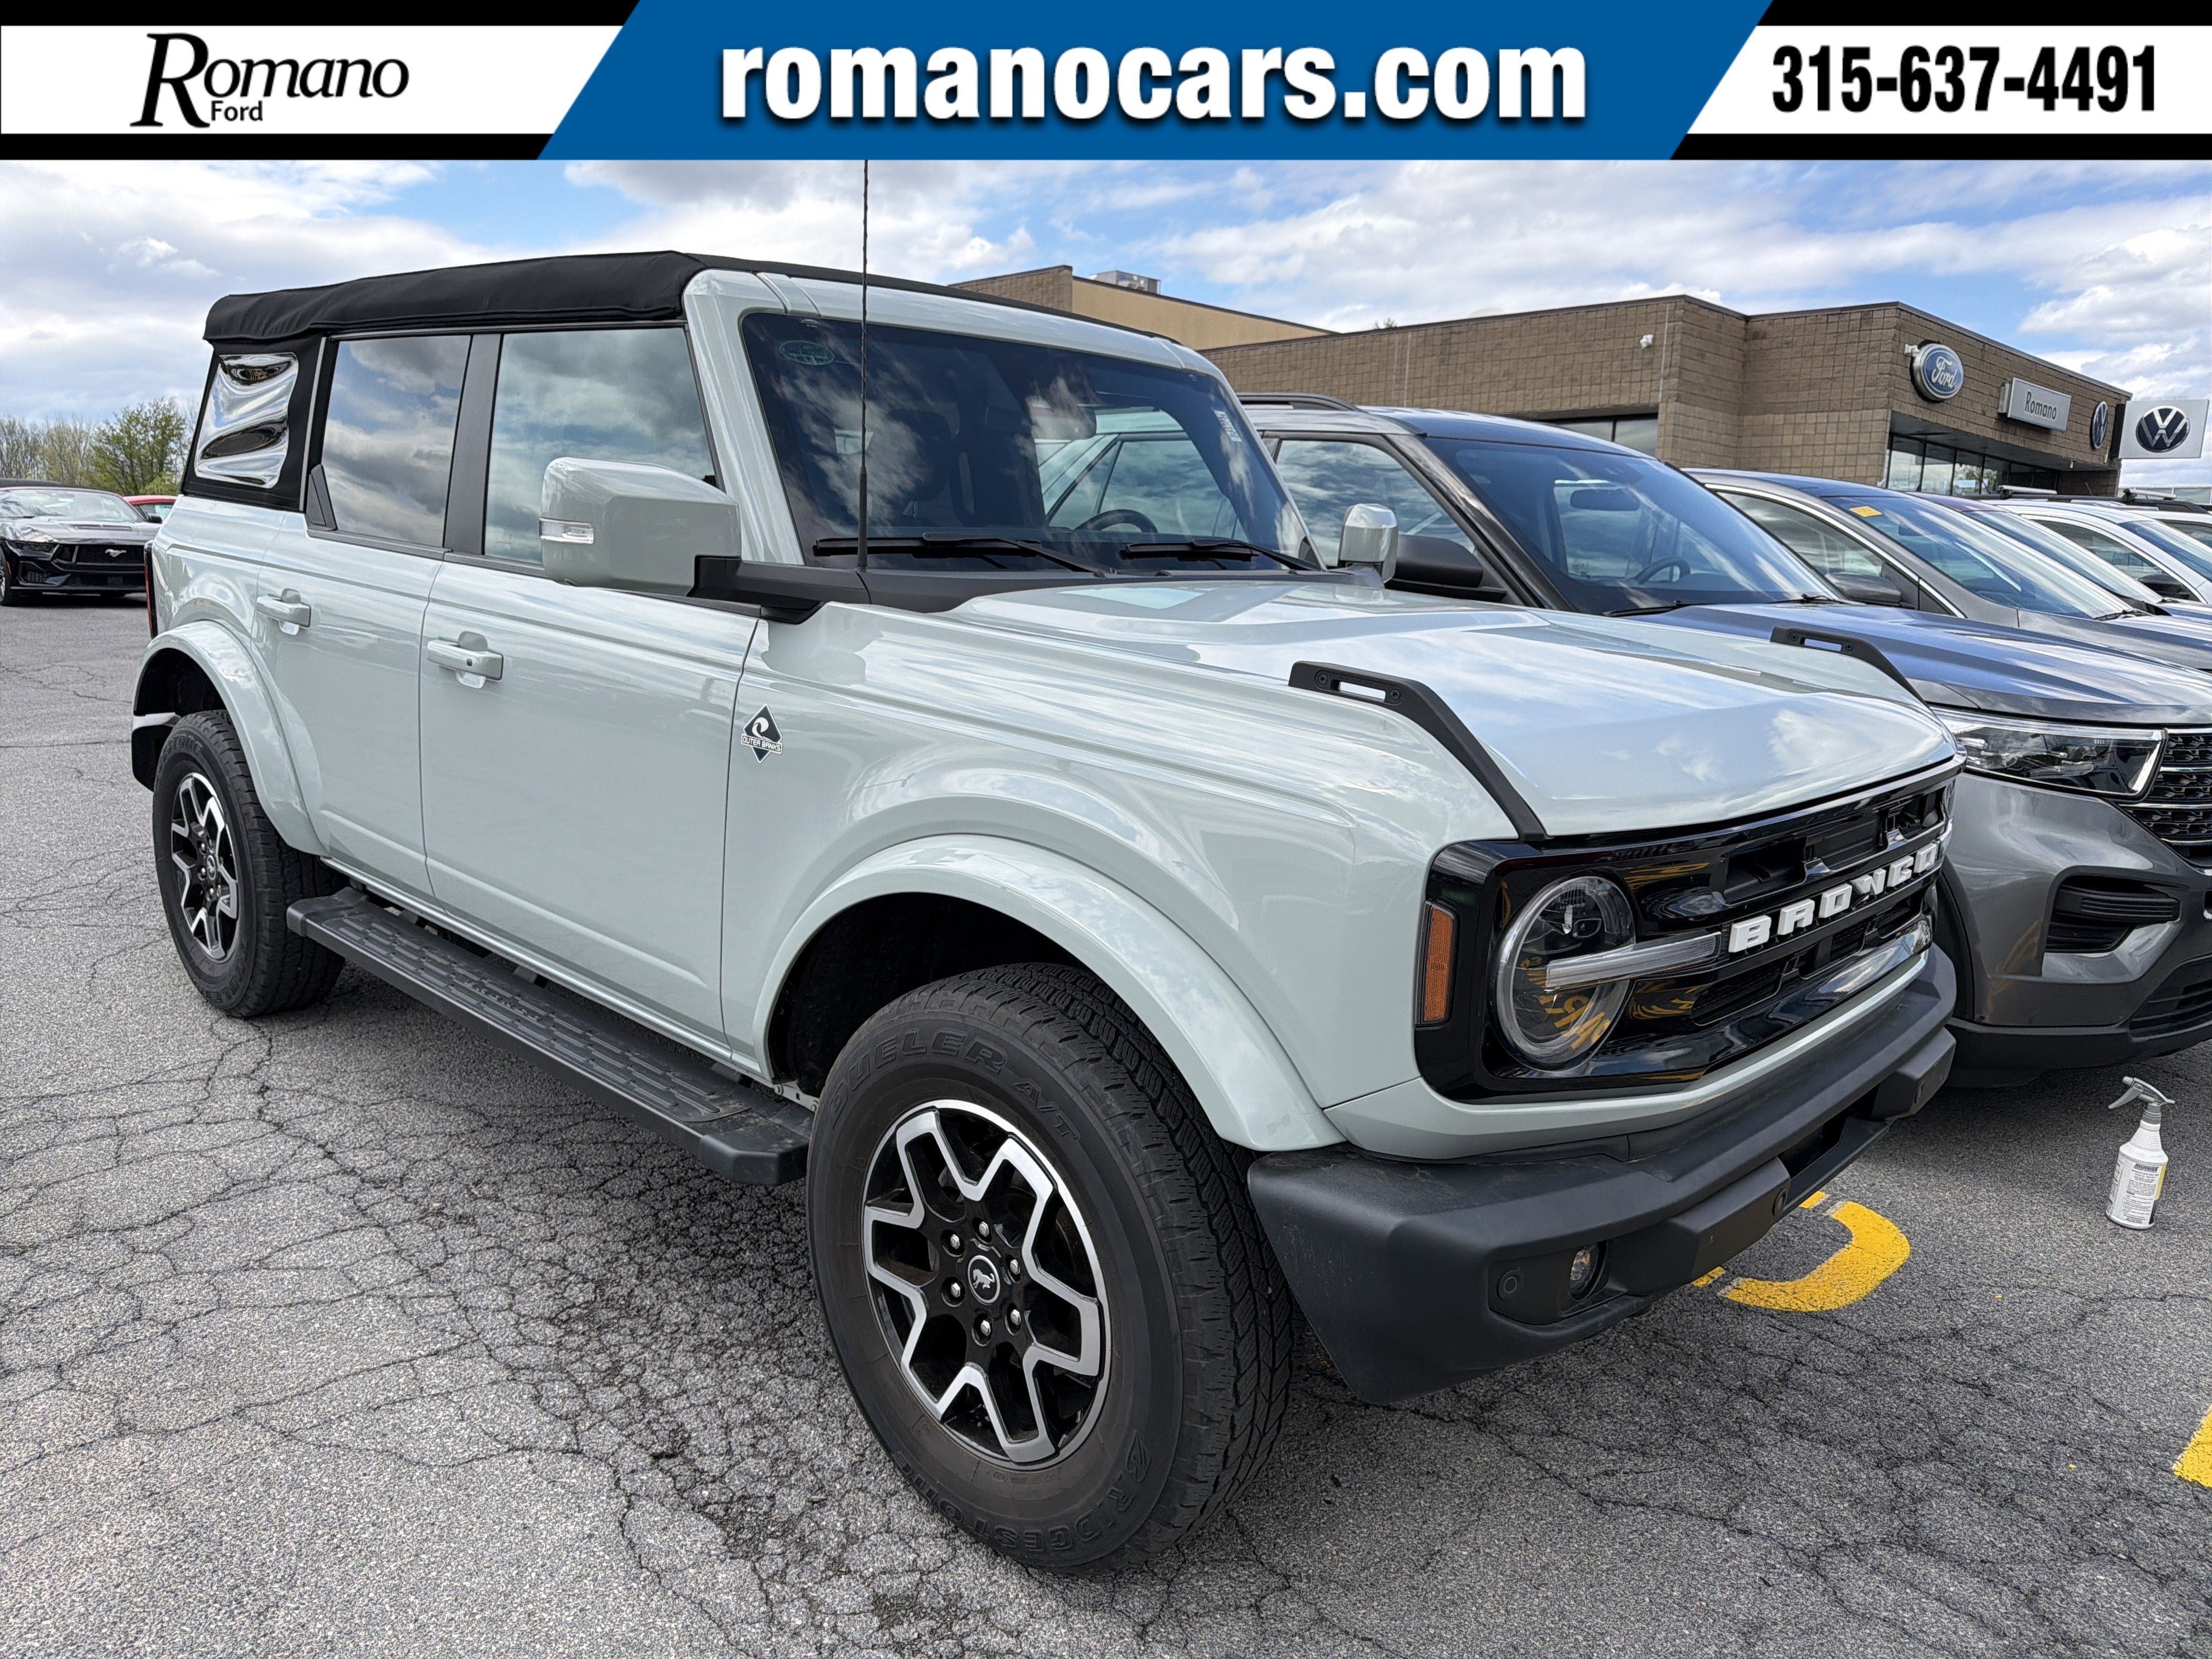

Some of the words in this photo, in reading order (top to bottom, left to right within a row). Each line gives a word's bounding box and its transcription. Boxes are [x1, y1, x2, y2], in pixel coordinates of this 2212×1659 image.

[1932, 356, 1957, 389] Ford
[2024, 390, 2057, 420] Romano
[742, 736, 761, 747] OUTER
[761, 741, 781, 752] BANKS
[1728, 842, 1939, 953] BRONCO
